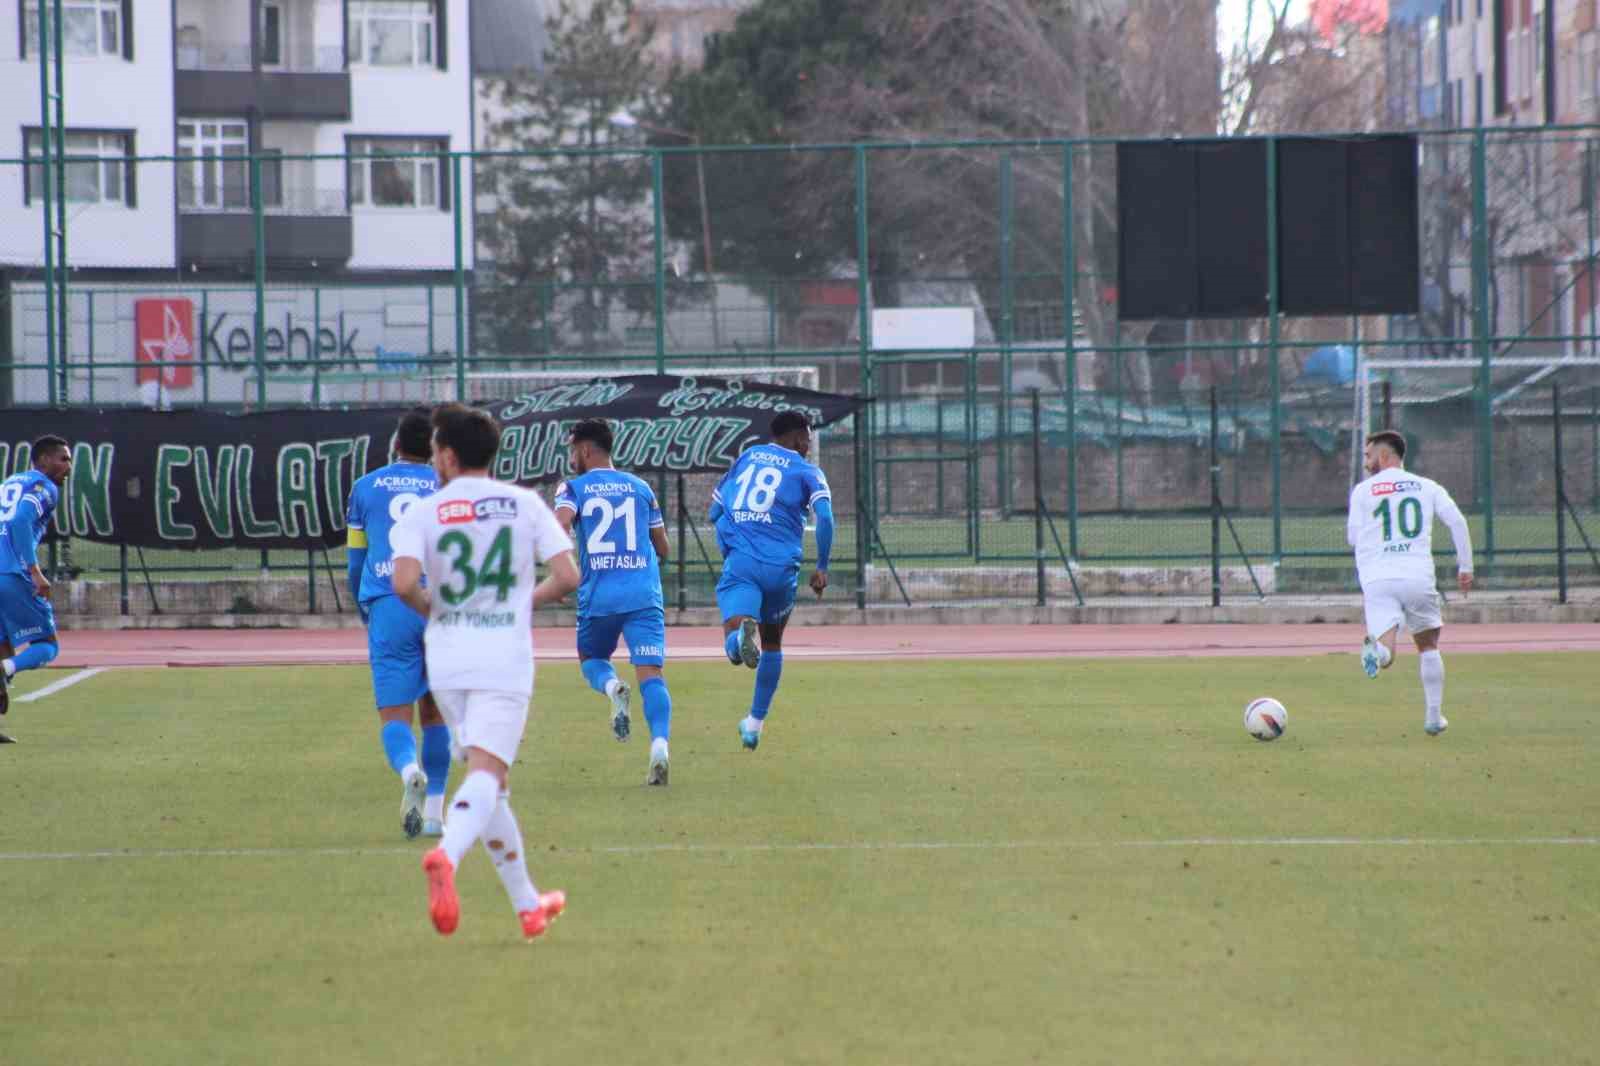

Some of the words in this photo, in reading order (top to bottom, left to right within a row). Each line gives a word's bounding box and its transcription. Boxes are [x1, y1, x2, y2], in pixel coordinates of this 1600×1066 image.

[200, 312, 361, 371] Keebek
[733, 463, 783, 513] 18
[581, 496, 637, 554] 21
[1373, 497, 1423, 541] 10
[437, 525, 517, 605] 34
